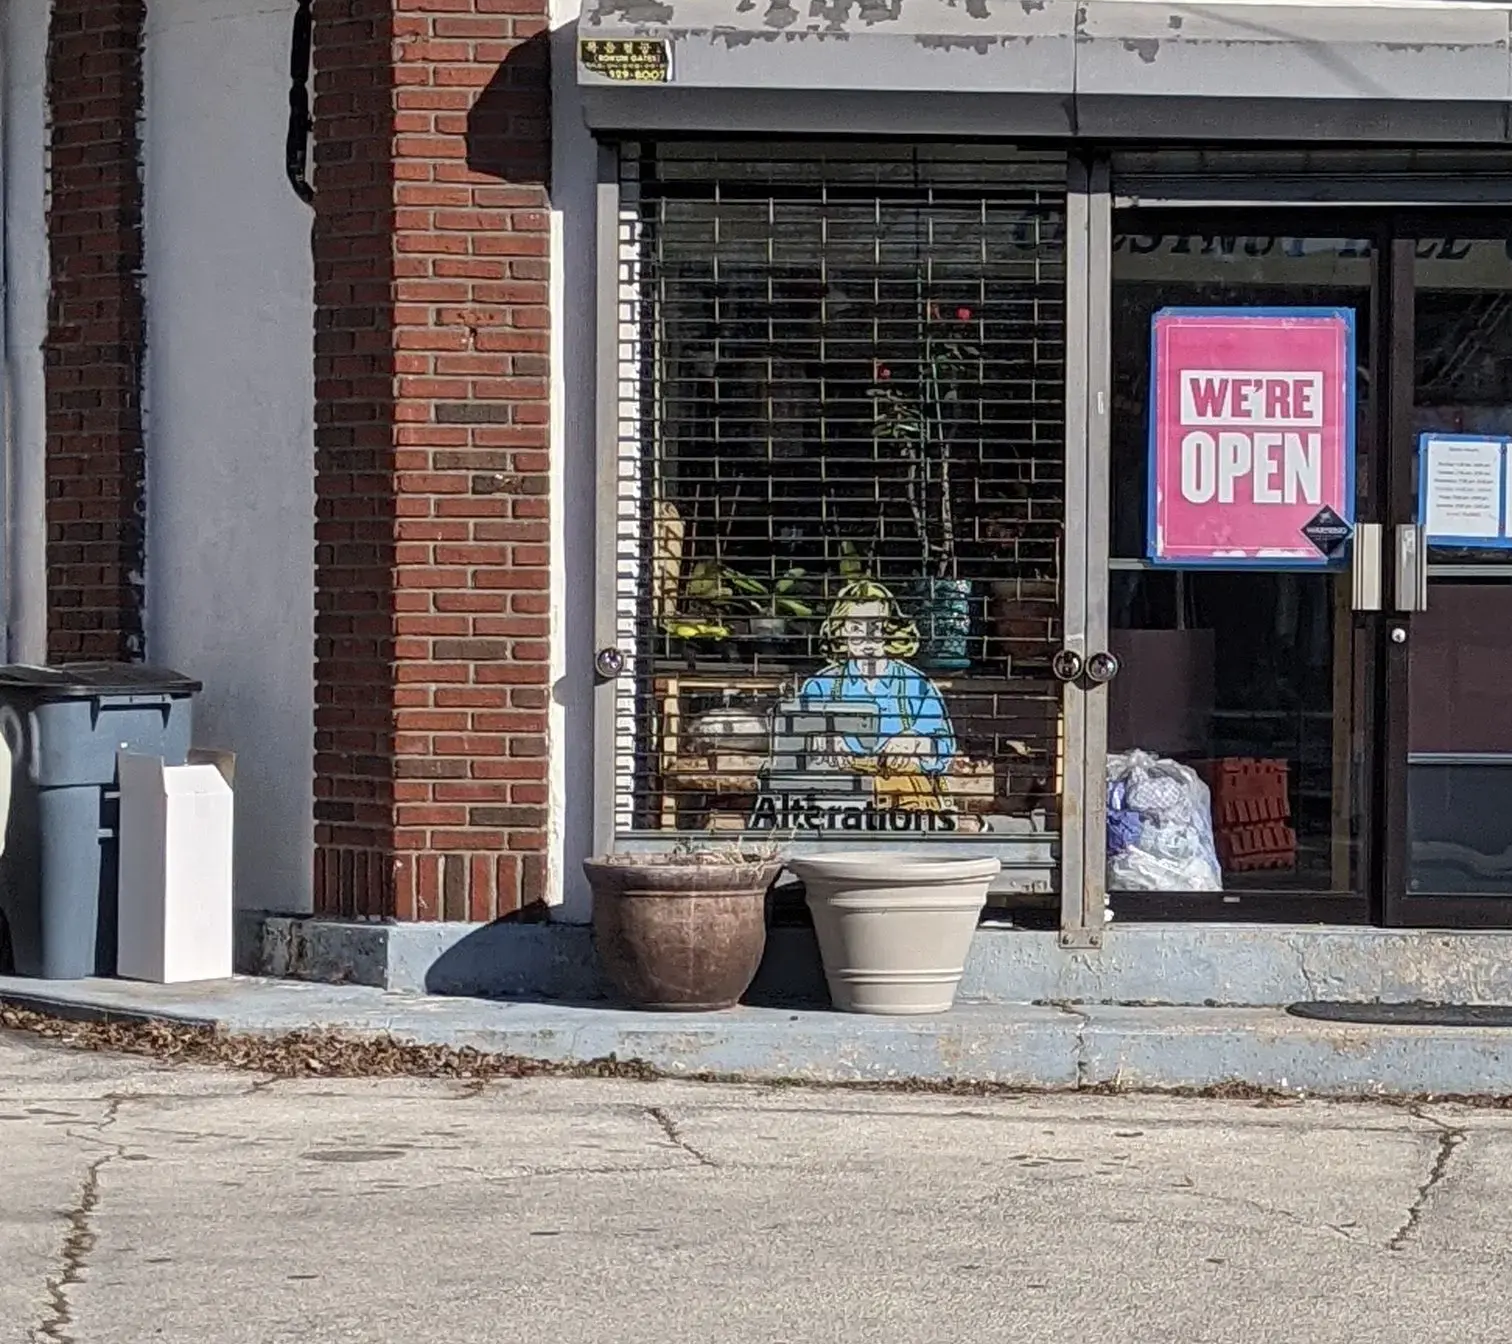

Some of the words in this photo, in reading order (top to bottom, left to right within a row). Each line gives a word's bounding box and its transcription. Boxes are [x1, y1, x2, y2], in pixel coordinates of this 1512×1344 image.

[1189, 377, 1314, 419] WE'RE
[1180, 430, 1322, 505] OPEN
[751, 793, 959, 831] Alterations
